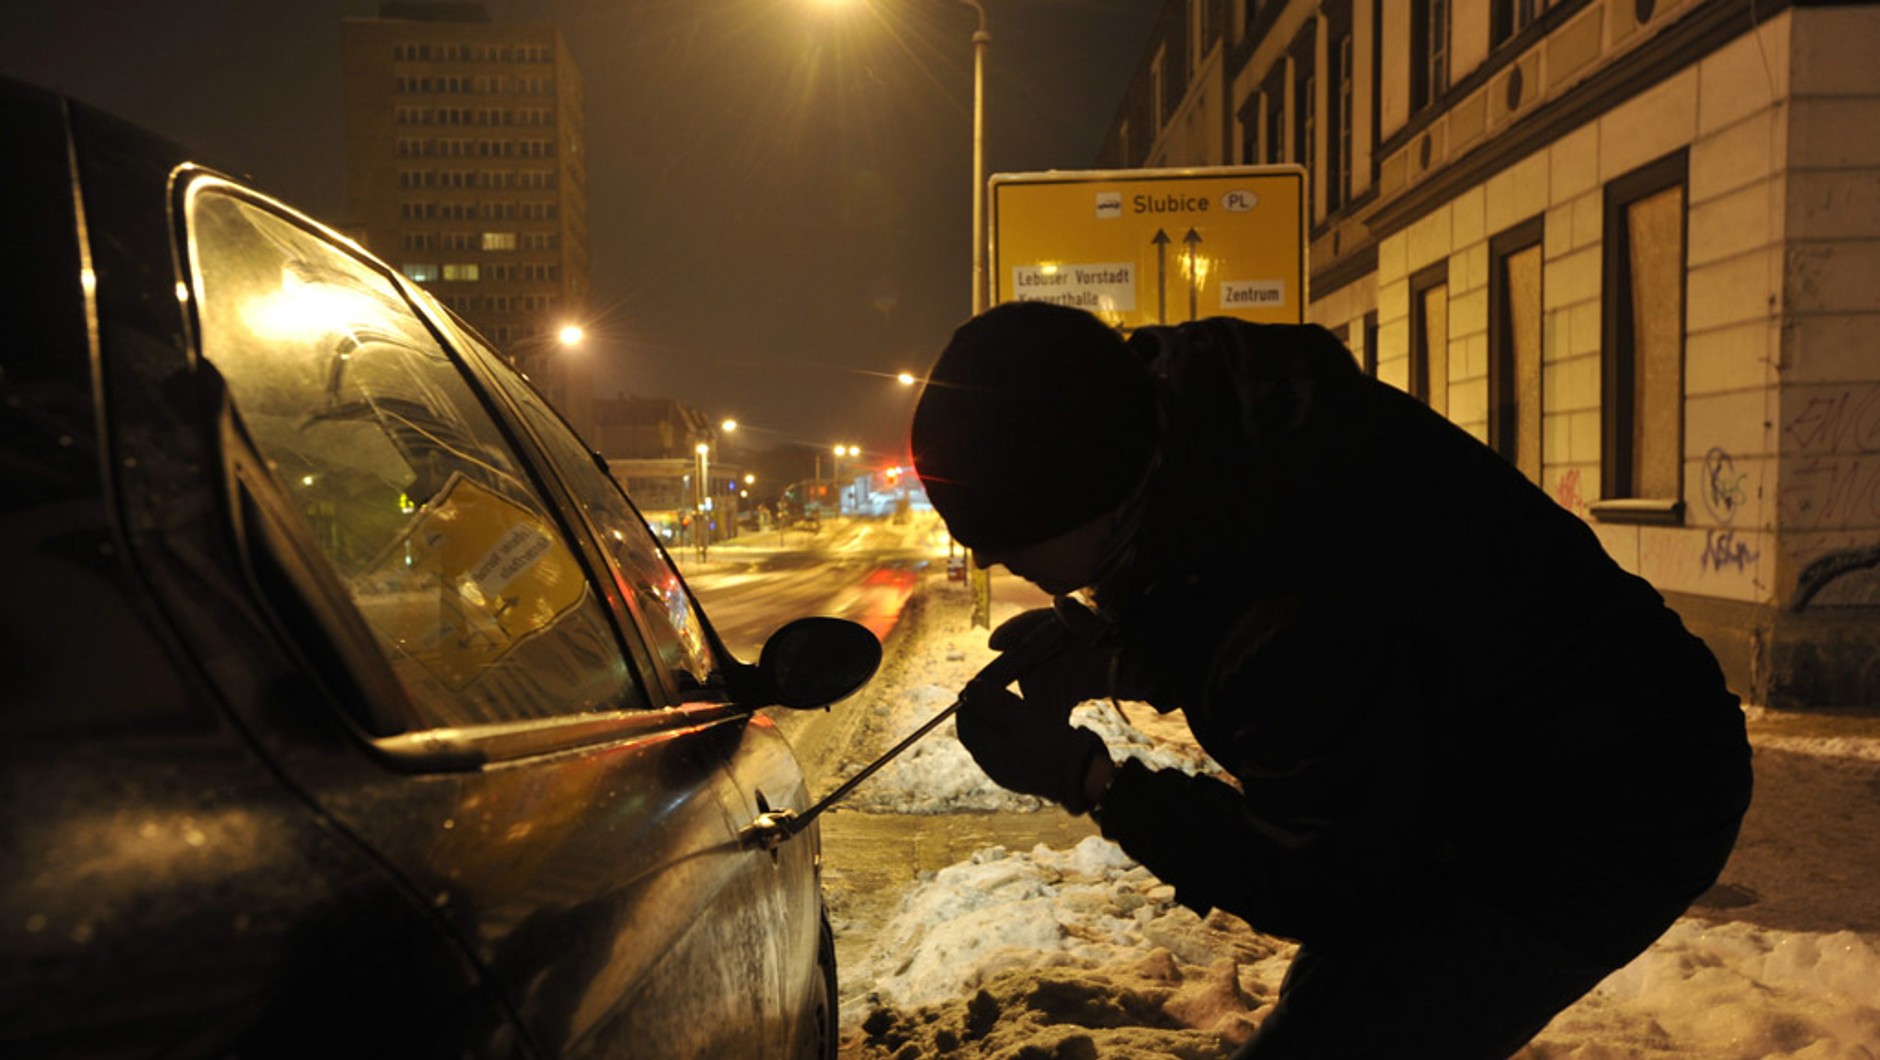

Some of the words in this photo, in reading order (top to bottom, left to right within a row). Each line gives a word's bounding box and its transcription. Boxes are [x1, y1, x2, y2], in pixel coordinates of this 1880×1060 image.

[1133, 193, 1209, 214] Slubice
[1227, 193, 1250, 209] PL
[1018, 270, 1068, 287] Lebuser
[1075, 267, 1129, 285] Vorstadt
[1225, 286, 1280, 302] Zentrum
